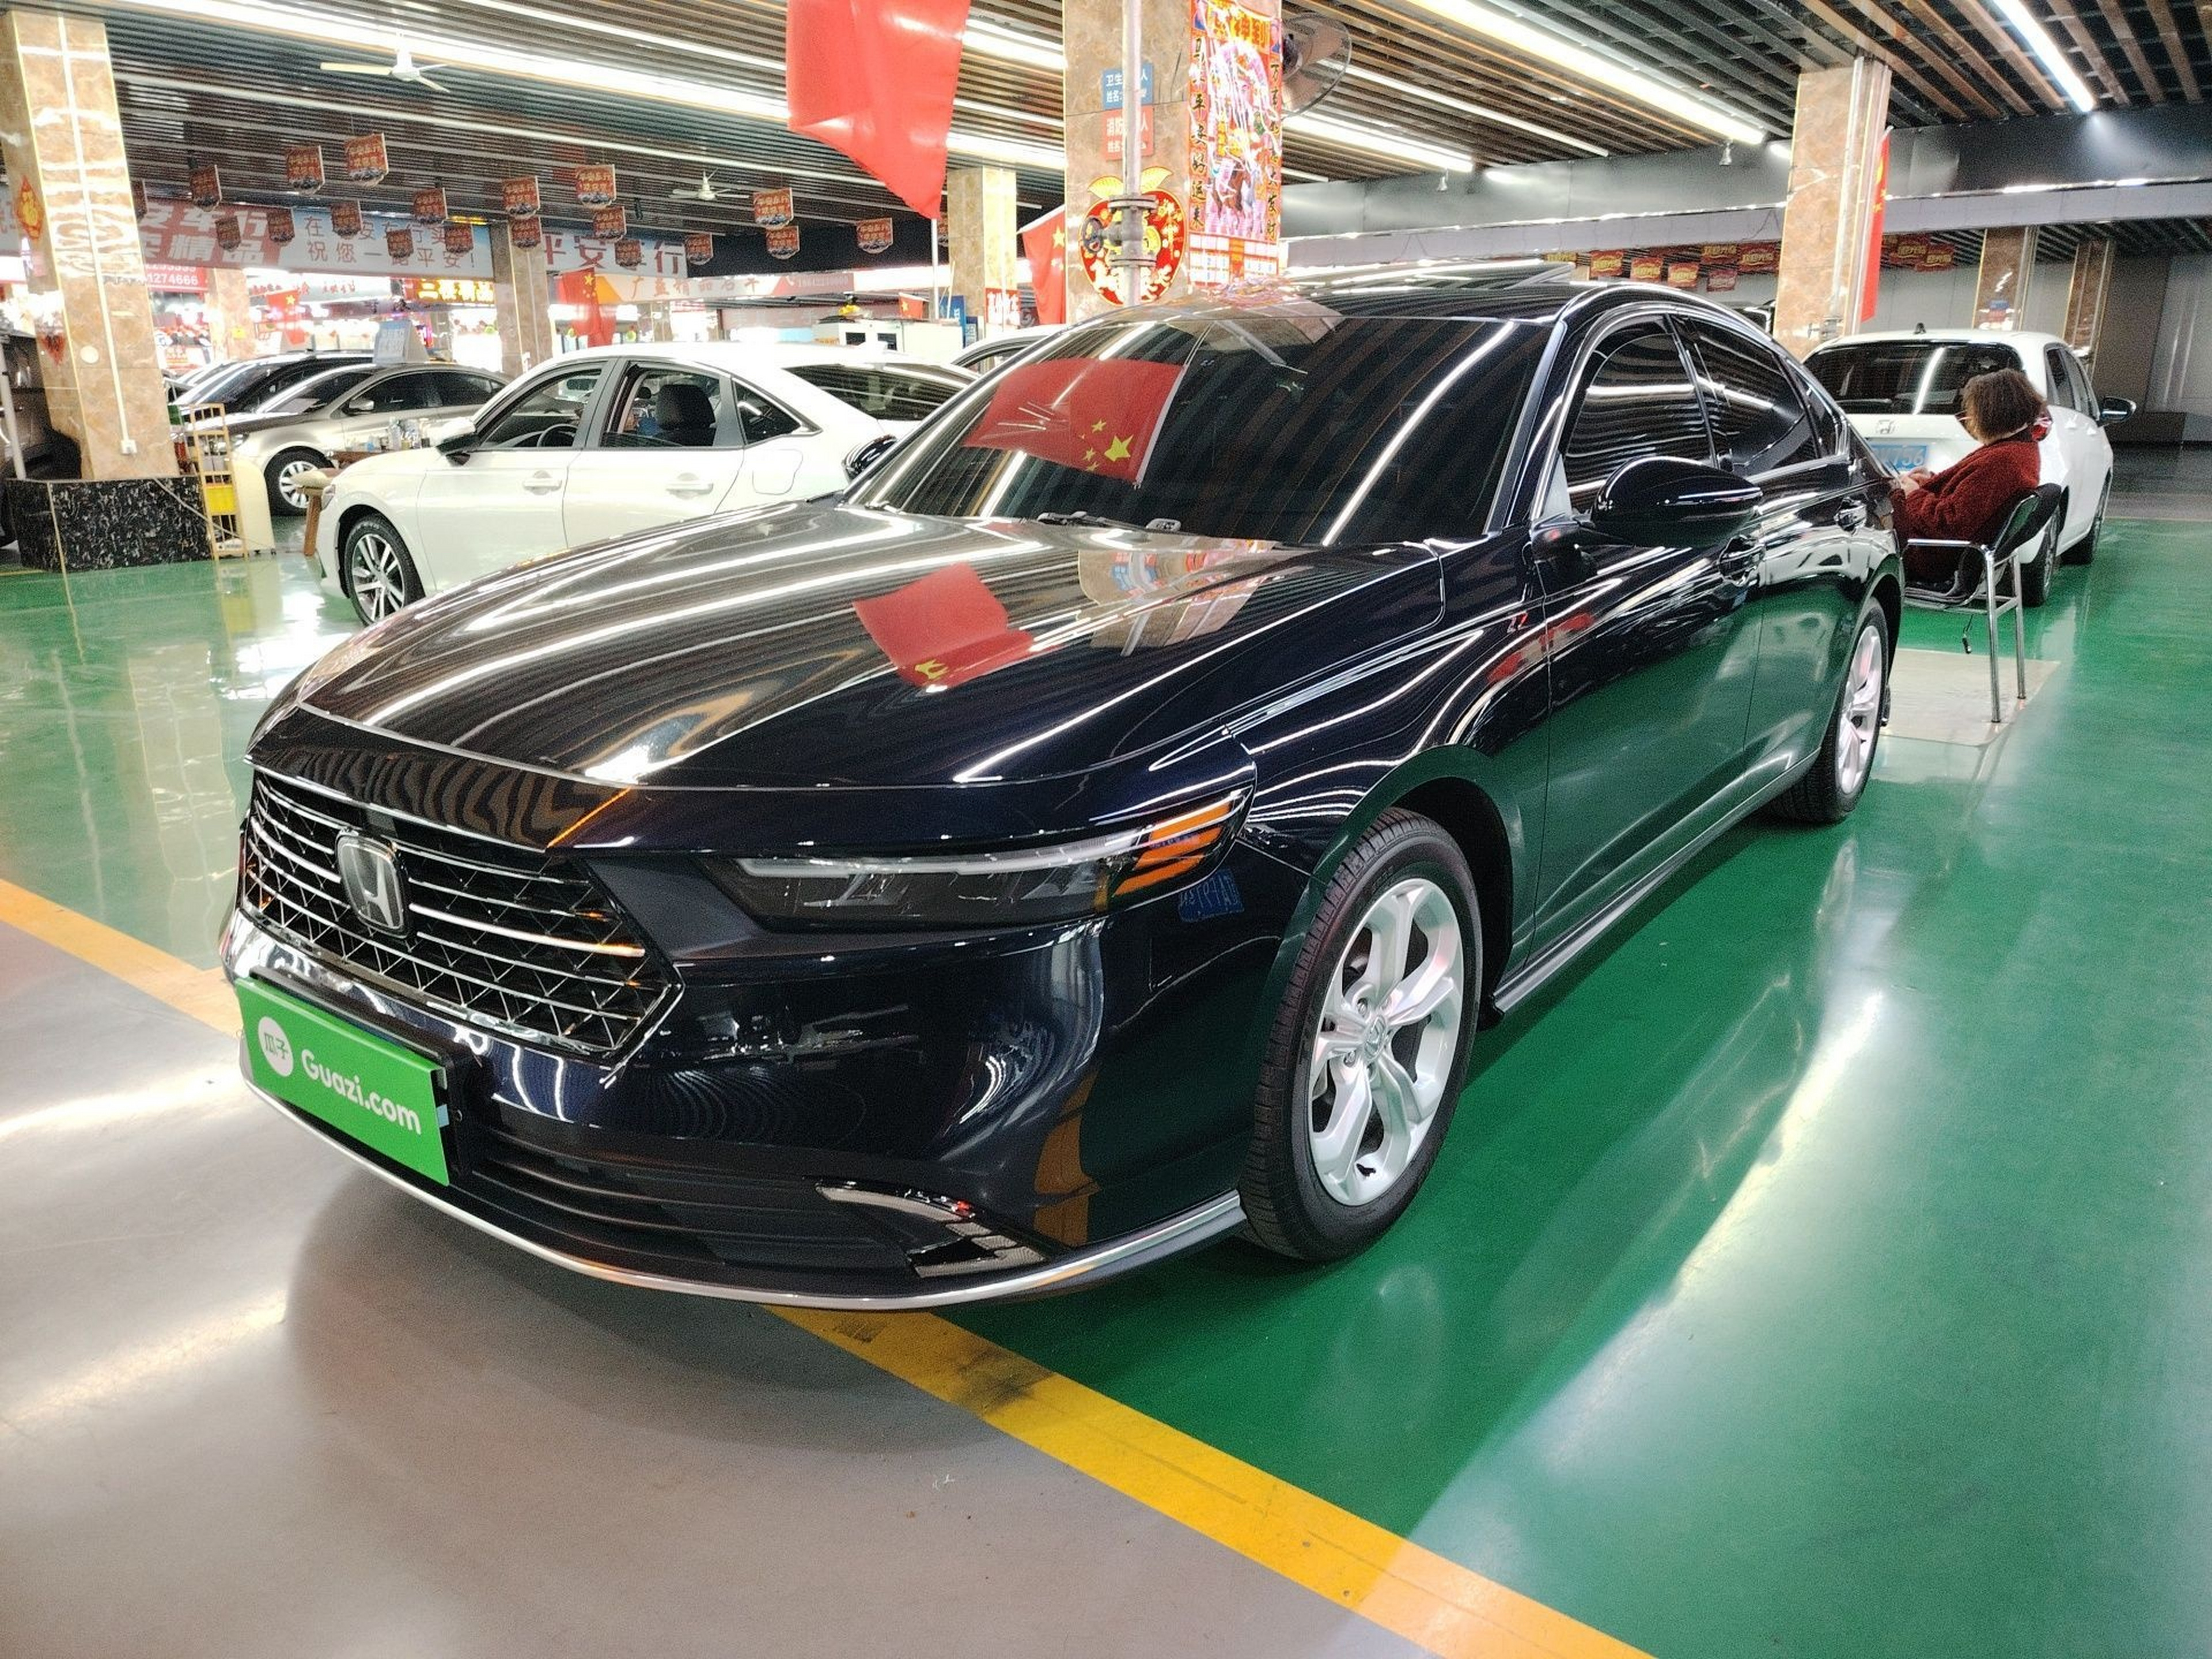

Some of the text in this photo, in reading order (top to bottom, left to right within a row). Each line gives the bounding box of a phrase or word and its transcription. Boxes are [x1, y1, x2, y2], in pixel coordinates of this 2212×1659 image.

[1106, 68, 1148, 87] 卫生人
[1107, 112, 1148, 137] 消防人
[263, 1031, 422, 1135] 瓜子 Guazi.com
